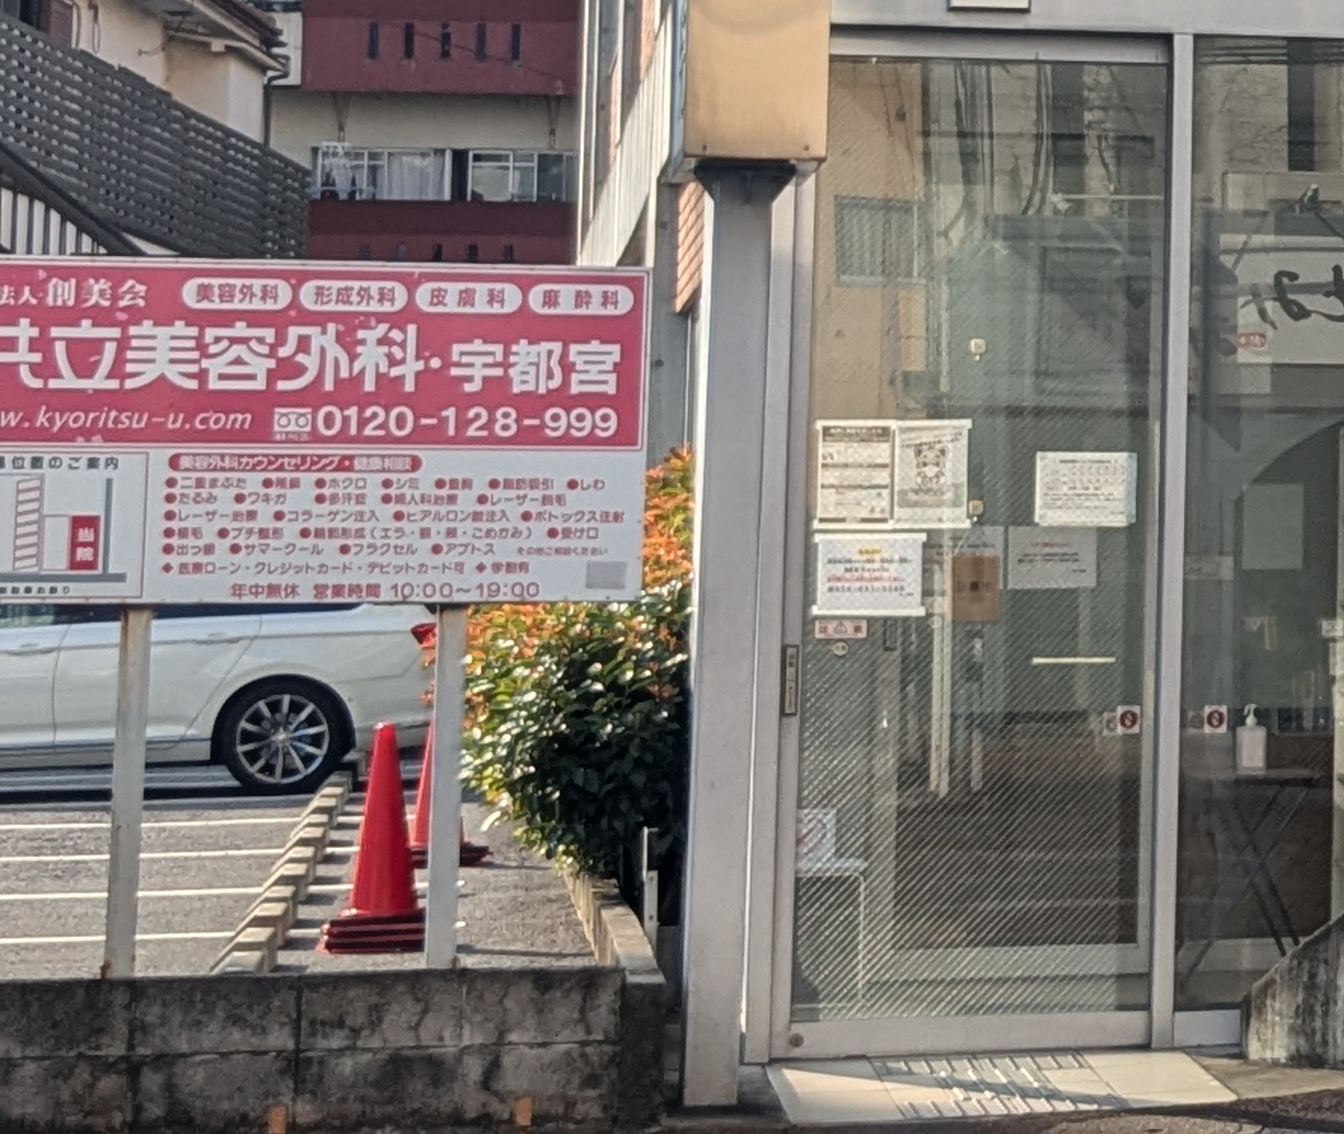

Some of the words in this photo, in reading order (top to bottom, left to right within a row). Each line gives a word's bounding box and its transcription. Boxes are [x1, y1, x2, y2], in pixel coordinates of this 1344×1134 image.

[46, 277, 148, 308] 創美会
[195, 283, 280, 306] 美容外科
[314, 285, 397, 307] 形成外科
[428, 286, 506, 308] 皮膚科
[541, 288, 620, 310] 麻酔科
[317, 405, 619, 439] 0120-128-999
[0, 456, 119, 471] 位置のご案内
[230, 583, 300, 599] 年中無休
[313, 583, 382, 599] 営業時間
